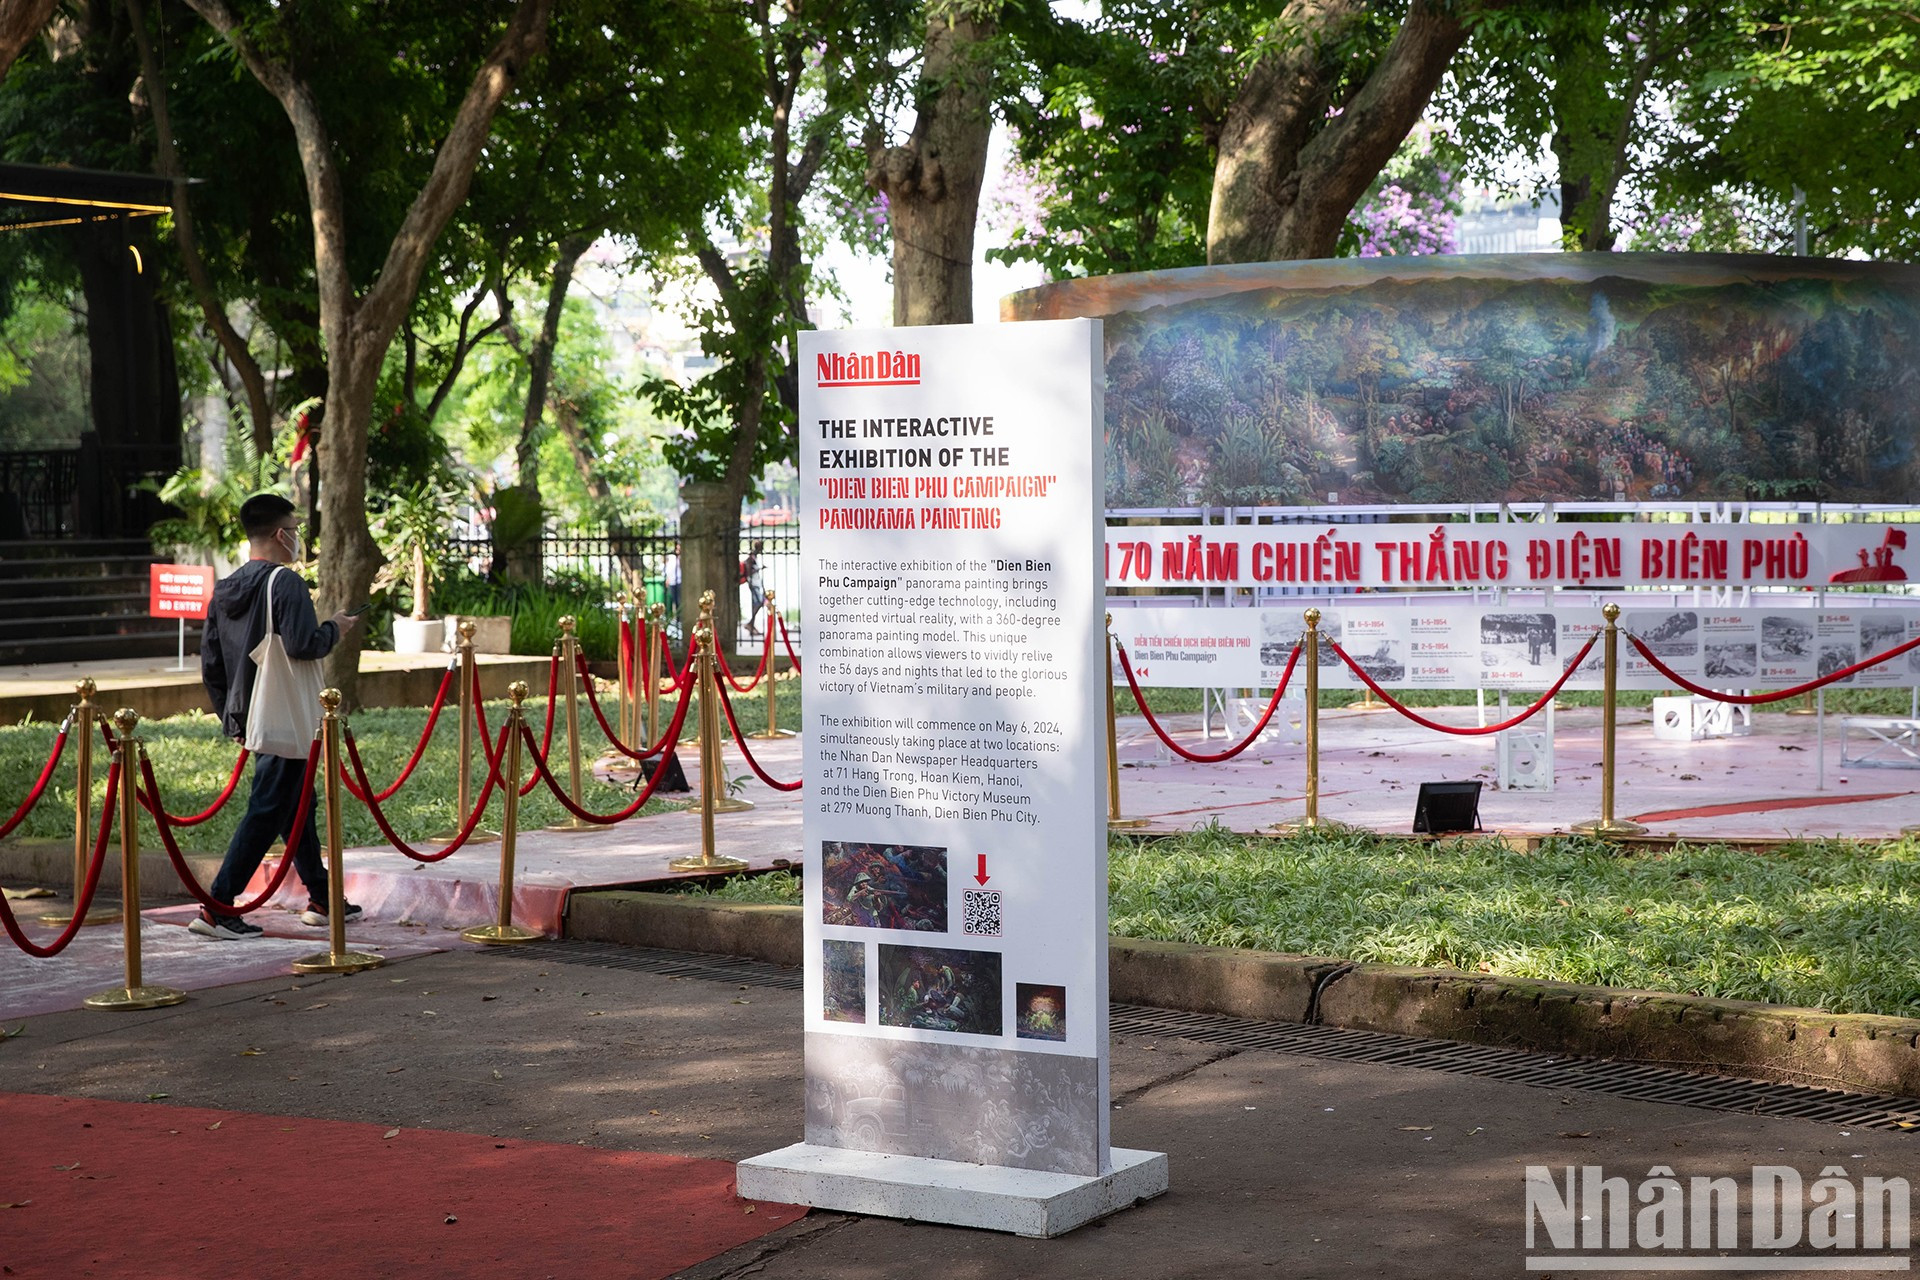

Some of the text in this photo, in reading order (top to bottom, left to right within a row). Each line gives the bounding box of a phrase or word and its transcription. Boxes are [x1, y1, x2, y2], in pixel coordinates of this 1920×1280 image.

[817, 350, 921, 381] Nhân Dân
[818, 416, 994, 439] THE INTERACTIVE
[820, 447, 1009, 469] EXHIBITION OF THE
[819, 475, 1056, 499] "DIEN BIEN PHU CAMPAIGN"
[820, 506, 1001, 530] PANORAMA PAINTING
[1117, 541, 1152, 582] 70
[1162, 534, 1239, 582] NĂM
[1252, 528, 1360, 582] CHIẾN
[1375, 525, 1508, 582] THẮNG
[1526, 531, 1621, 584] ĐIỆN
[1641, 532, 1727, 580] BIÊN
[1743, 531, 1808, 579] PHỦ
[819, 559, 1051, 572] The interactive exhibition of the "Dien Bien
[819, 576, 1048, 592] Phu Campaign" panorama painting brings
[159, 600, 202, 612] NO ENTRY
[819, 594, 1057, 610] together cutting-edge technology, including
[819, 612, 1061, 628] augmented virtual reality, with a 360-degree
[819, 630, 1027, 646] panorama painting model. This unique
[819, 647, 1053, 663] combination allows viewers to vividly relive
[1135, 650, 1217, 663] Dien Bien Phu Campaign
[819, 663, 1068, 681] the 56 days and nights that led to the glorious
[1422, 667, 1449, 675] 5-5-1954
[1491, 671, 1523, 679] 30-4-1954
[819, 681, 1036, 700] victory of Vietnam's military and people.
[820, 714, 1063, 736] The exhibition will commence on May 6, 2024,
[820, 734, 1060, 752] simultaneously taking place at two locations:
[820, 750, 1038, 770] the Nhan Dan Newspaper Headquarters
[823, 767, 1023, 788] at 71 Hang Trong, Hoan Kiem, Hanoi,
[820, 784, 1031, 805] and the Dien Bien Phu Victory Museum
[820, 802, 1040, 826] at 279 Muong Thanh, Dien Bien Phu City.
